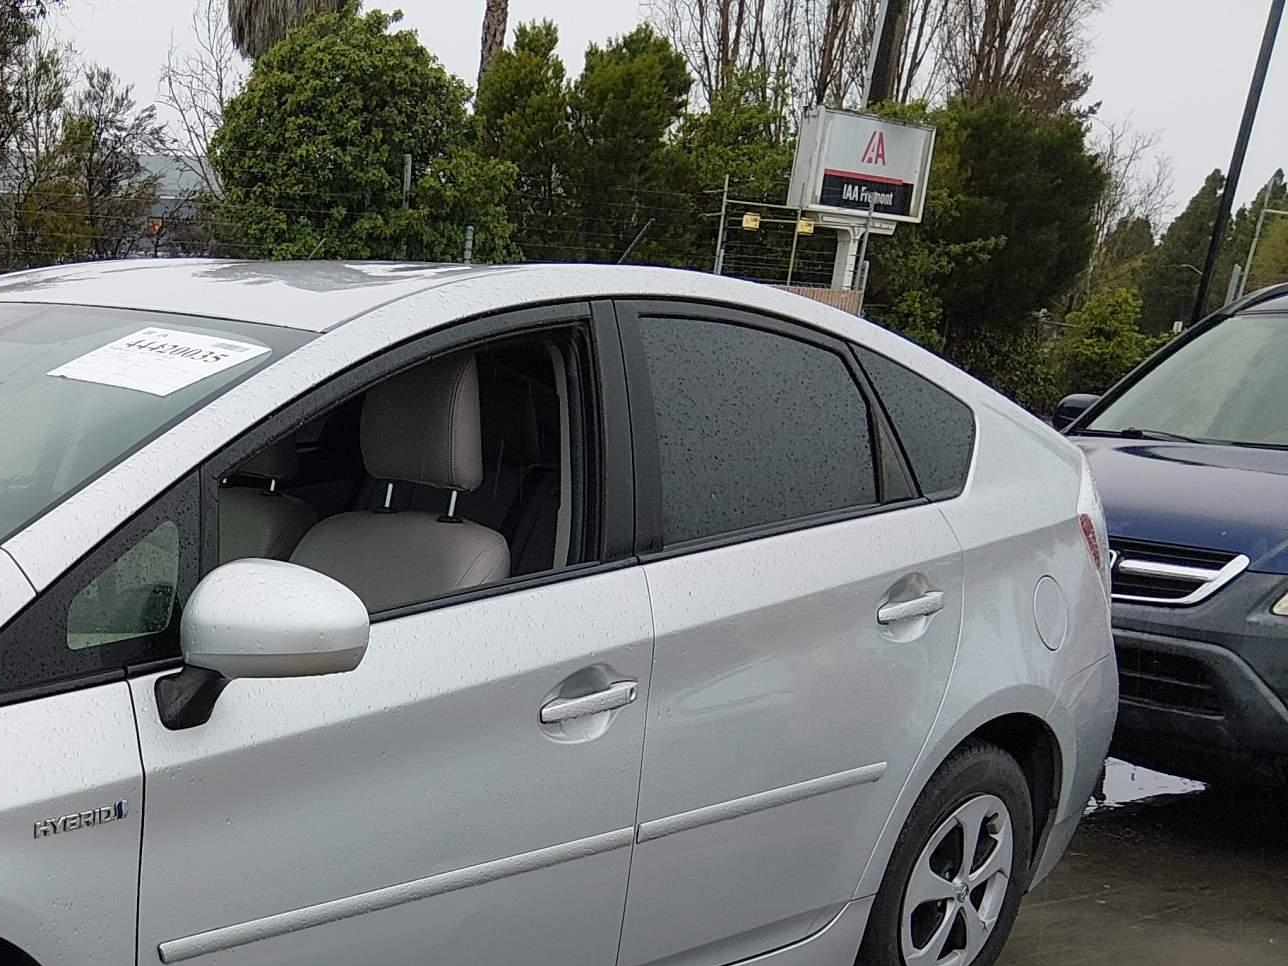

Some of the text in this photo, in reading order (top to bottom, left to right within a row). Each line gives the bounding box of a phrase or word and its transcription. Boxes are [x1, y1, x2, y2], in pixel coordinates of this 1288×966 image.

[842, 183, 859, 201] IAA
[126, 338, 229, 363] 44420035
[33, 806, 113, 839] HYBRID
